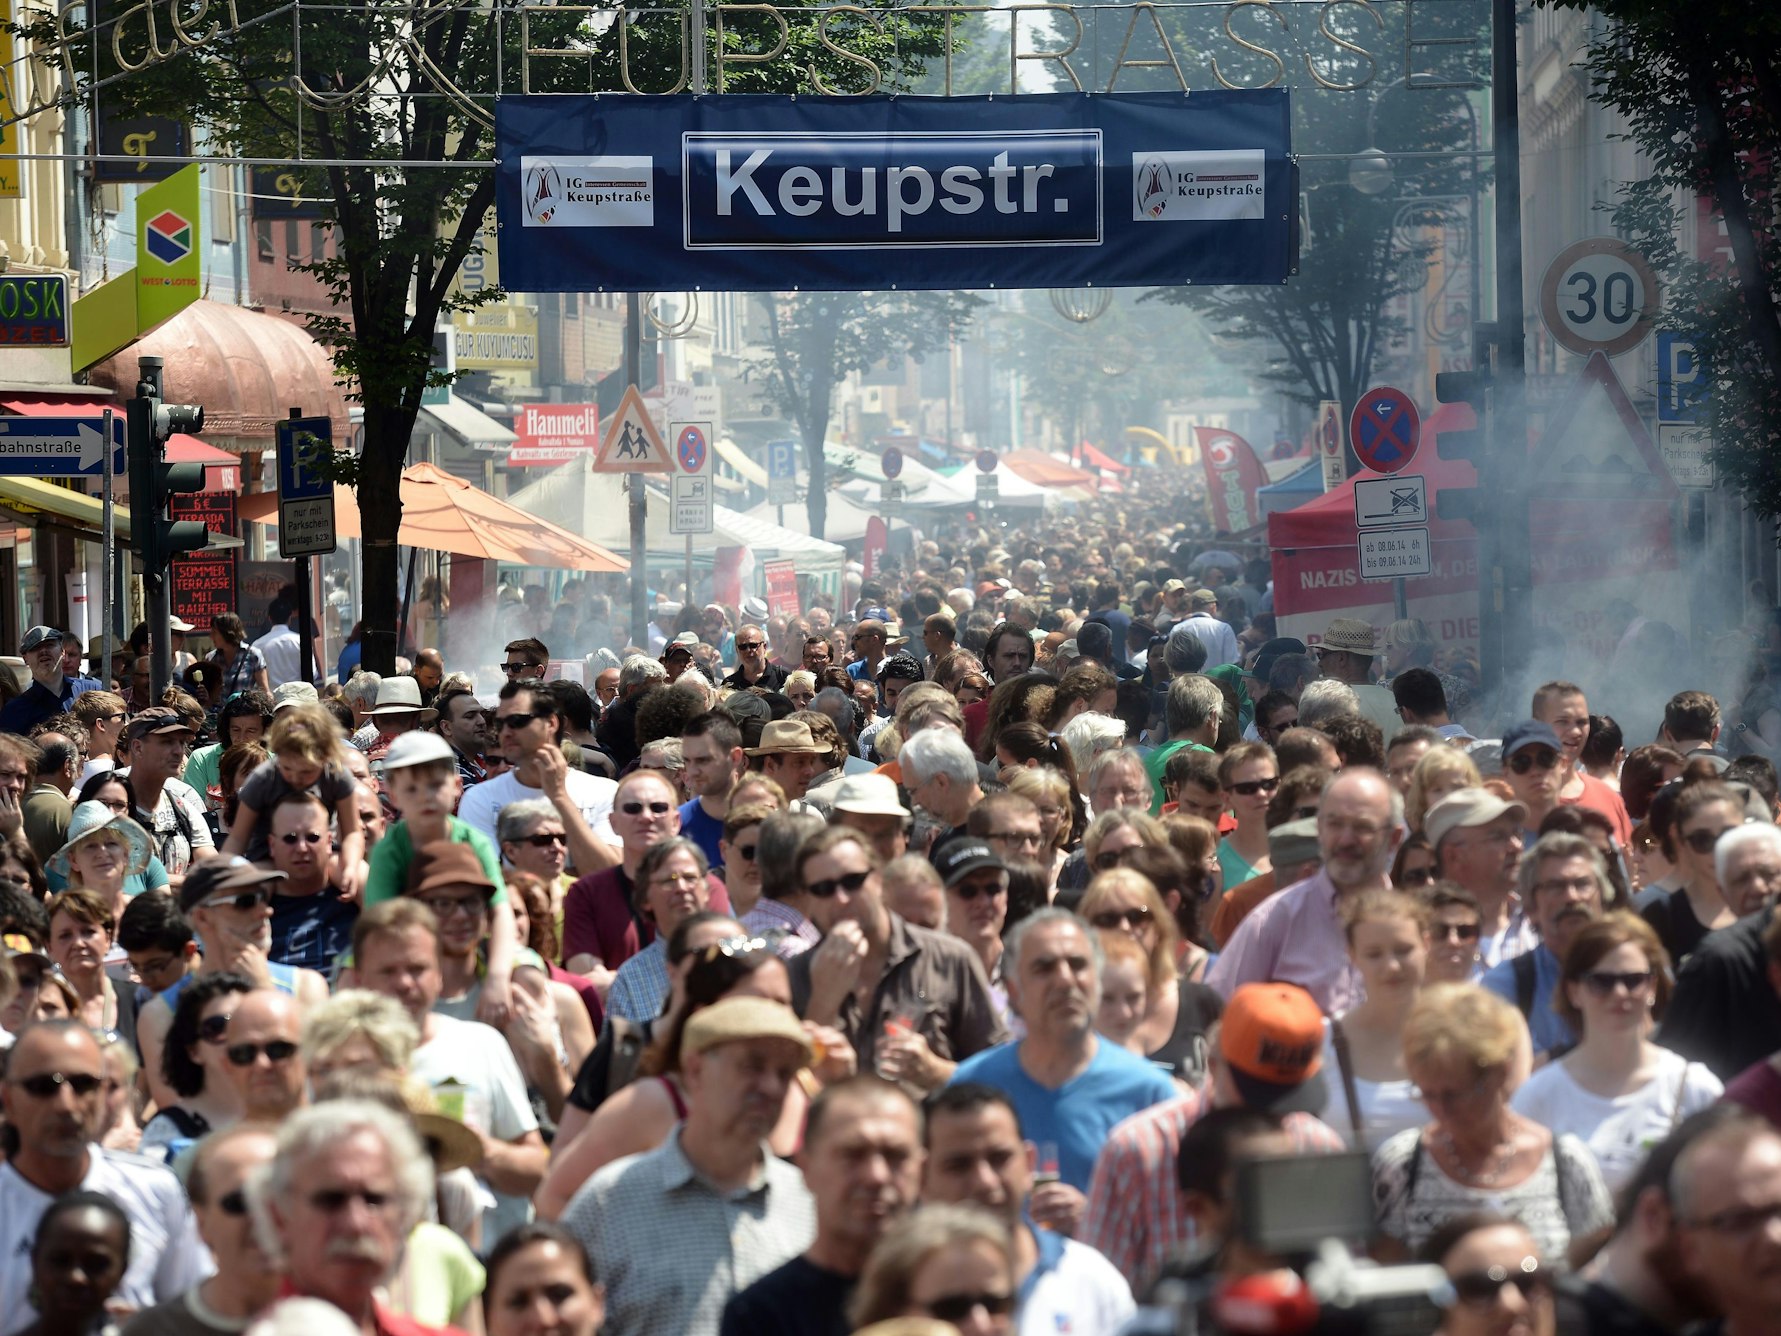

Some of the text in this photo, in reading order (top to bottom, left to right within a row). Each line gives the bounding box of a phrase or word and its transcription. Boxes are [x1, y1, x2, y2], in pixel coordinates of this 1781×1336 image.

[566, 178, 582, 189] IG
[1178, 172, 1194, 183] IG
[715, 149, 1069, 232] Keupstr.
[1178, 183, 1262, 199] Keupstraße
[567, 190, 651, 206] Keupstraße
[141, 276, 197, 287] WEST LOTTO
[1566, 271, 1634, 324] 30
[477, 333, 535, 361] KUYUMCUSU
[1670, 342, 1700, 411] P
[292, 430, 319, 489] P
[294, 505, 322, 518] nur mit
[288, 518, 329, 531] Parkschein
[1366, 539, 1420, 553] ab 08.06.14 6h
[1367, 557, 1377, 568] bis
[1379, 556, 1406, 567] 09.06.14
[179, 566, 226, 578] SOMMER
[176, 577, 230, 591] TERRASSE
[1300, 569, 1357, 591] NAZIS
[192, 591, 213, 603] MIT
[177, 602, 228, 616] RAUCHER
